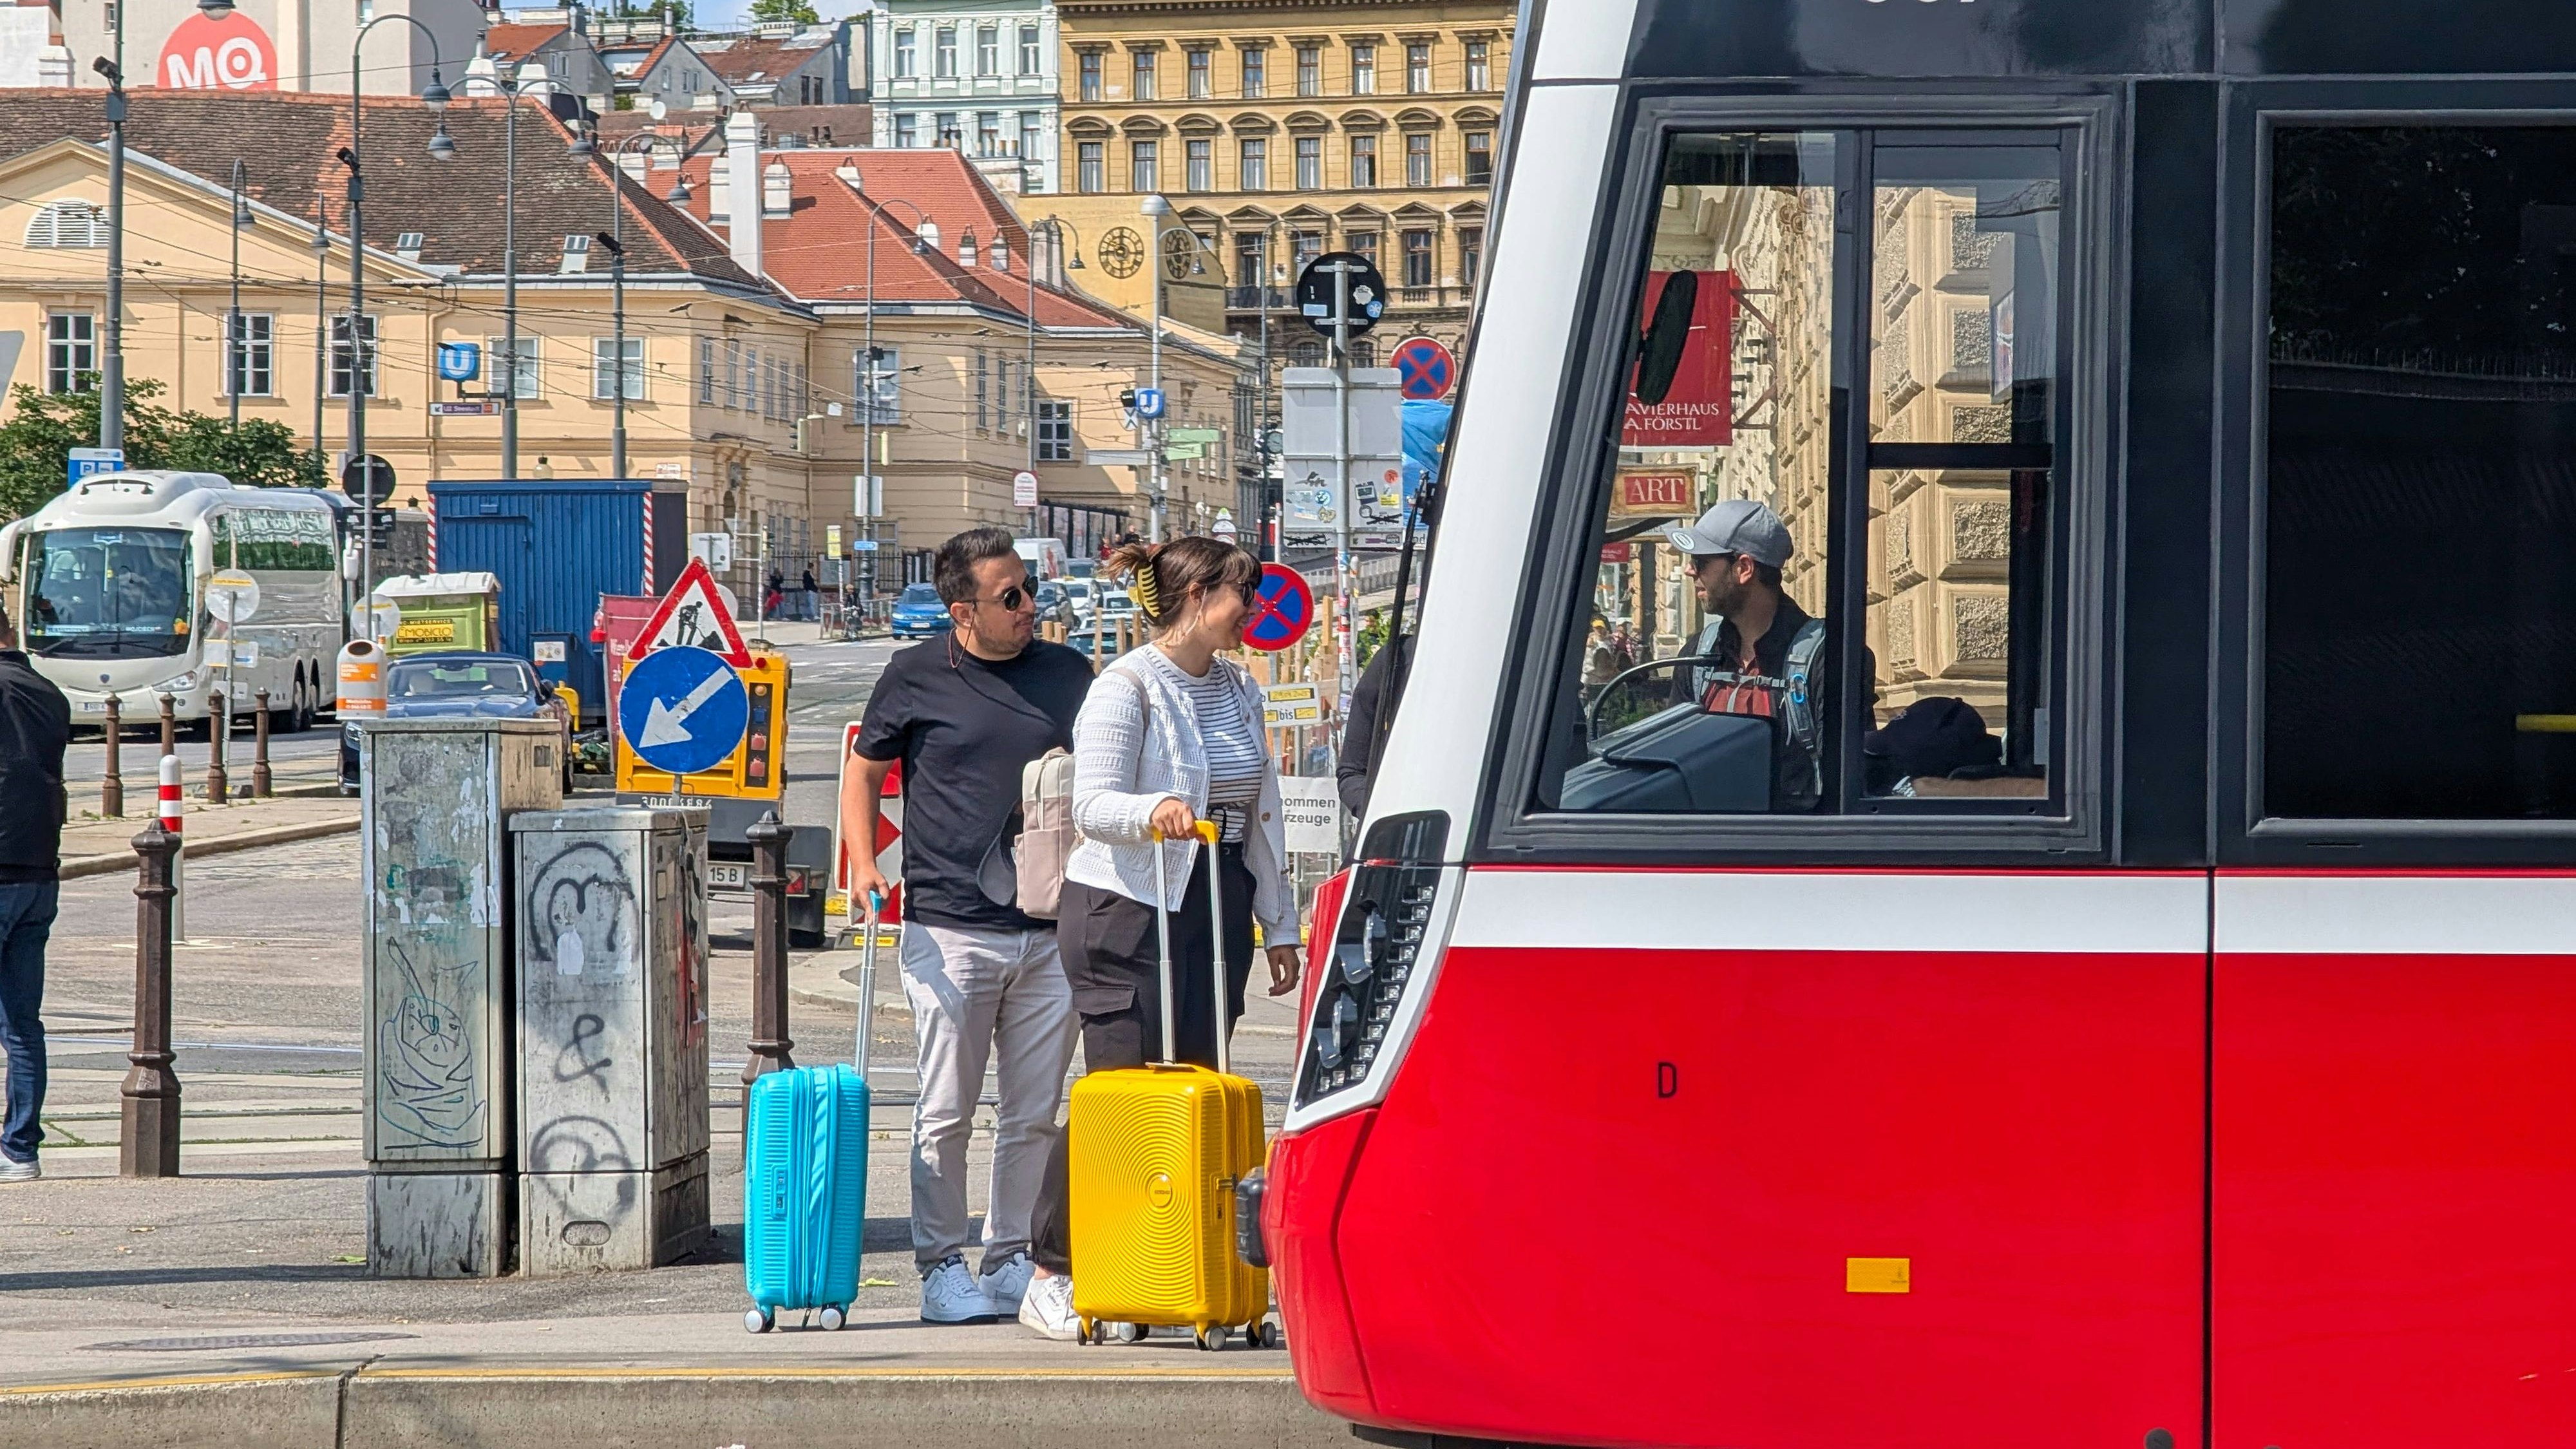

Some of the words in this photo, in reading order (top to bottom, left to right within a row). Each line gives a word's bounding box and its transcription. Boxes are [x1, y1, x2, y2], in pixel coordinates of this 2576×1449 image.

[166, 36, 267, 90] MQ
[445, 350, 470, 375] U
[1139, 393, 1159, 414] U
[1628, 477, 1684, 502] ART
[1279, 709, 1294, 720] bis
[710, 867, 725, 882] 15
[729, 869, 738, 882] B
[1658, 1061, 1678, 1099] D
